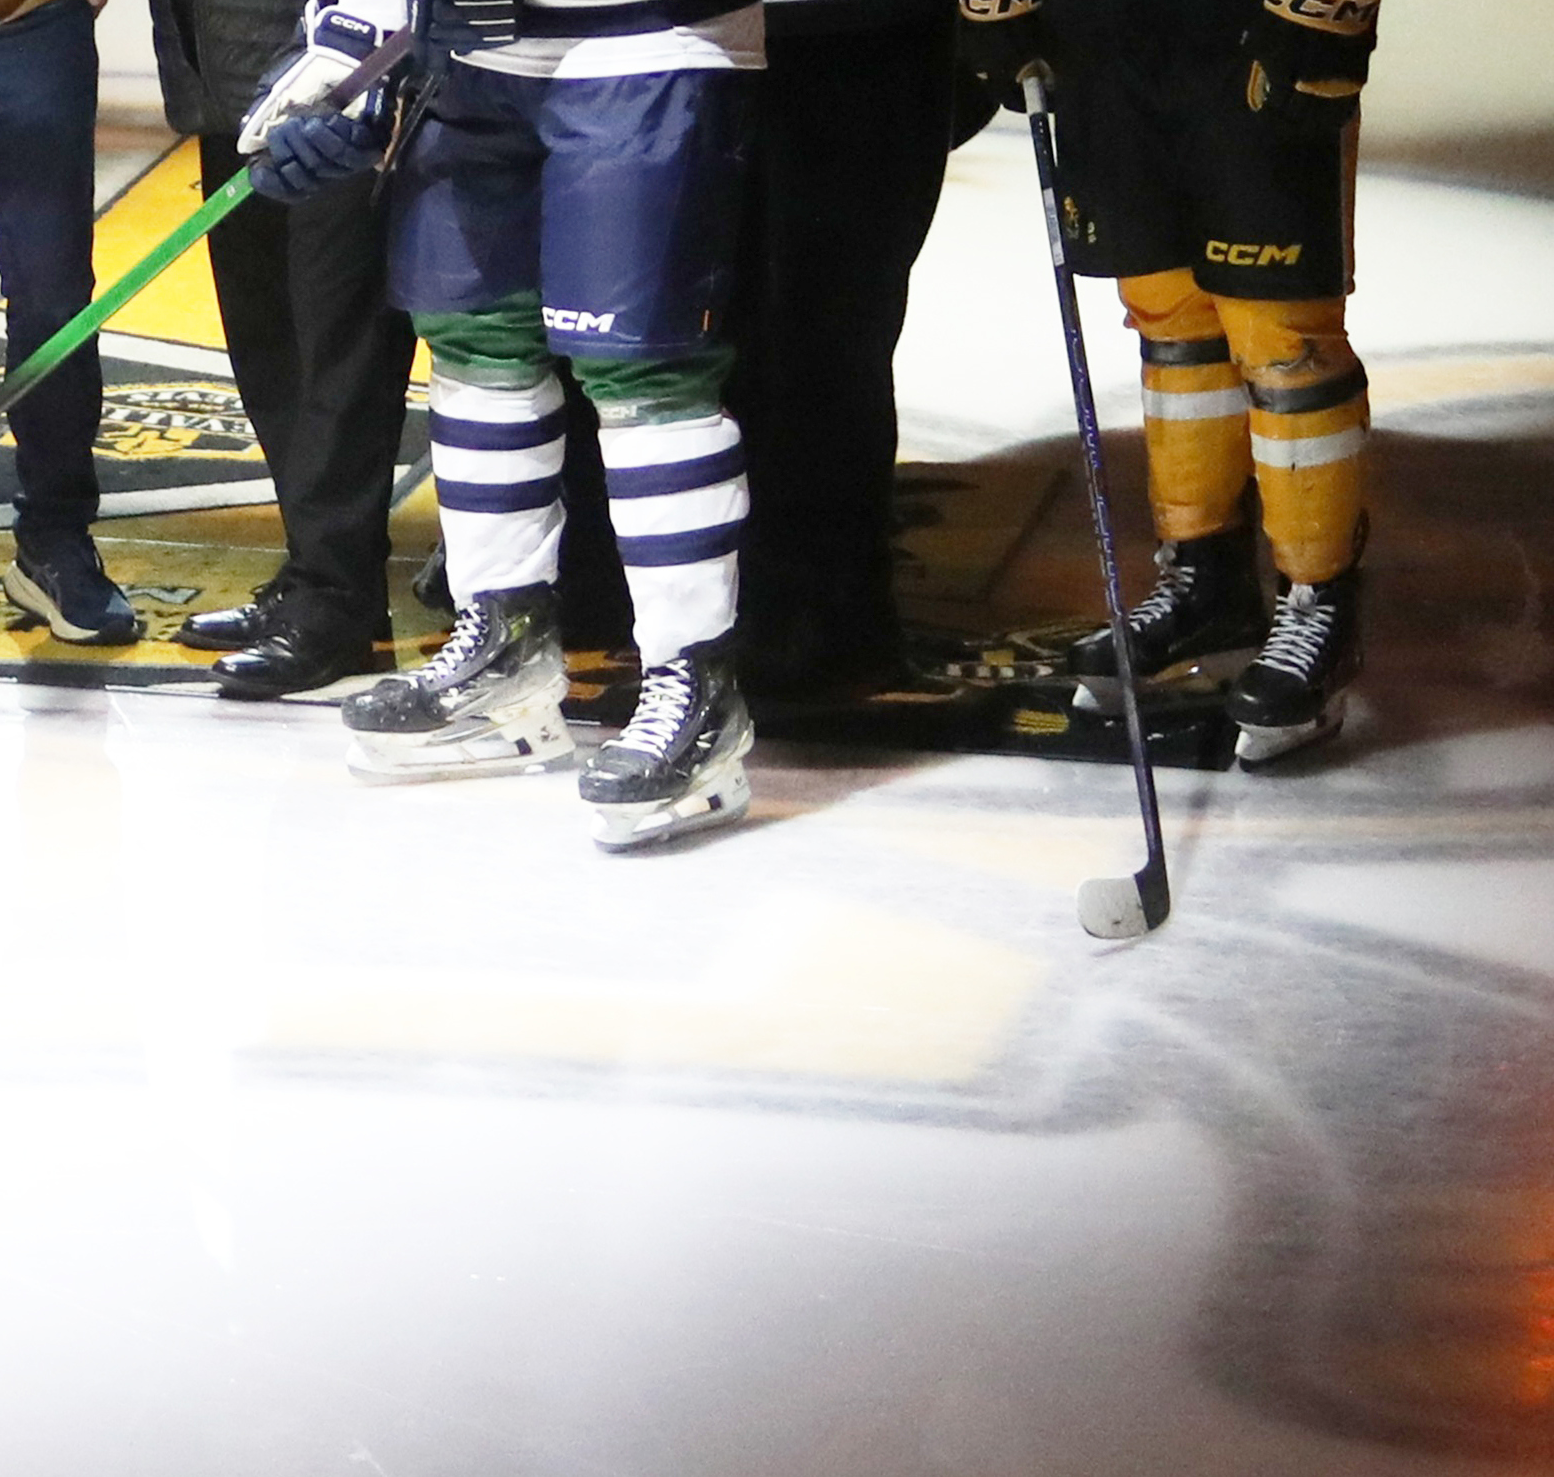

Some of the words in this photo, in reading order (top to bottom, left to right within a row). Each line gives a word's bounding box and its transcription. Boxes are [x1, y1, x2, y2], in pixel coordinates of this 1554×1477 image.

[329, 14, 372, 35] CCM
[1204, 239, 1303, 266] CCM
[541, 305, 616, 333] CCM
